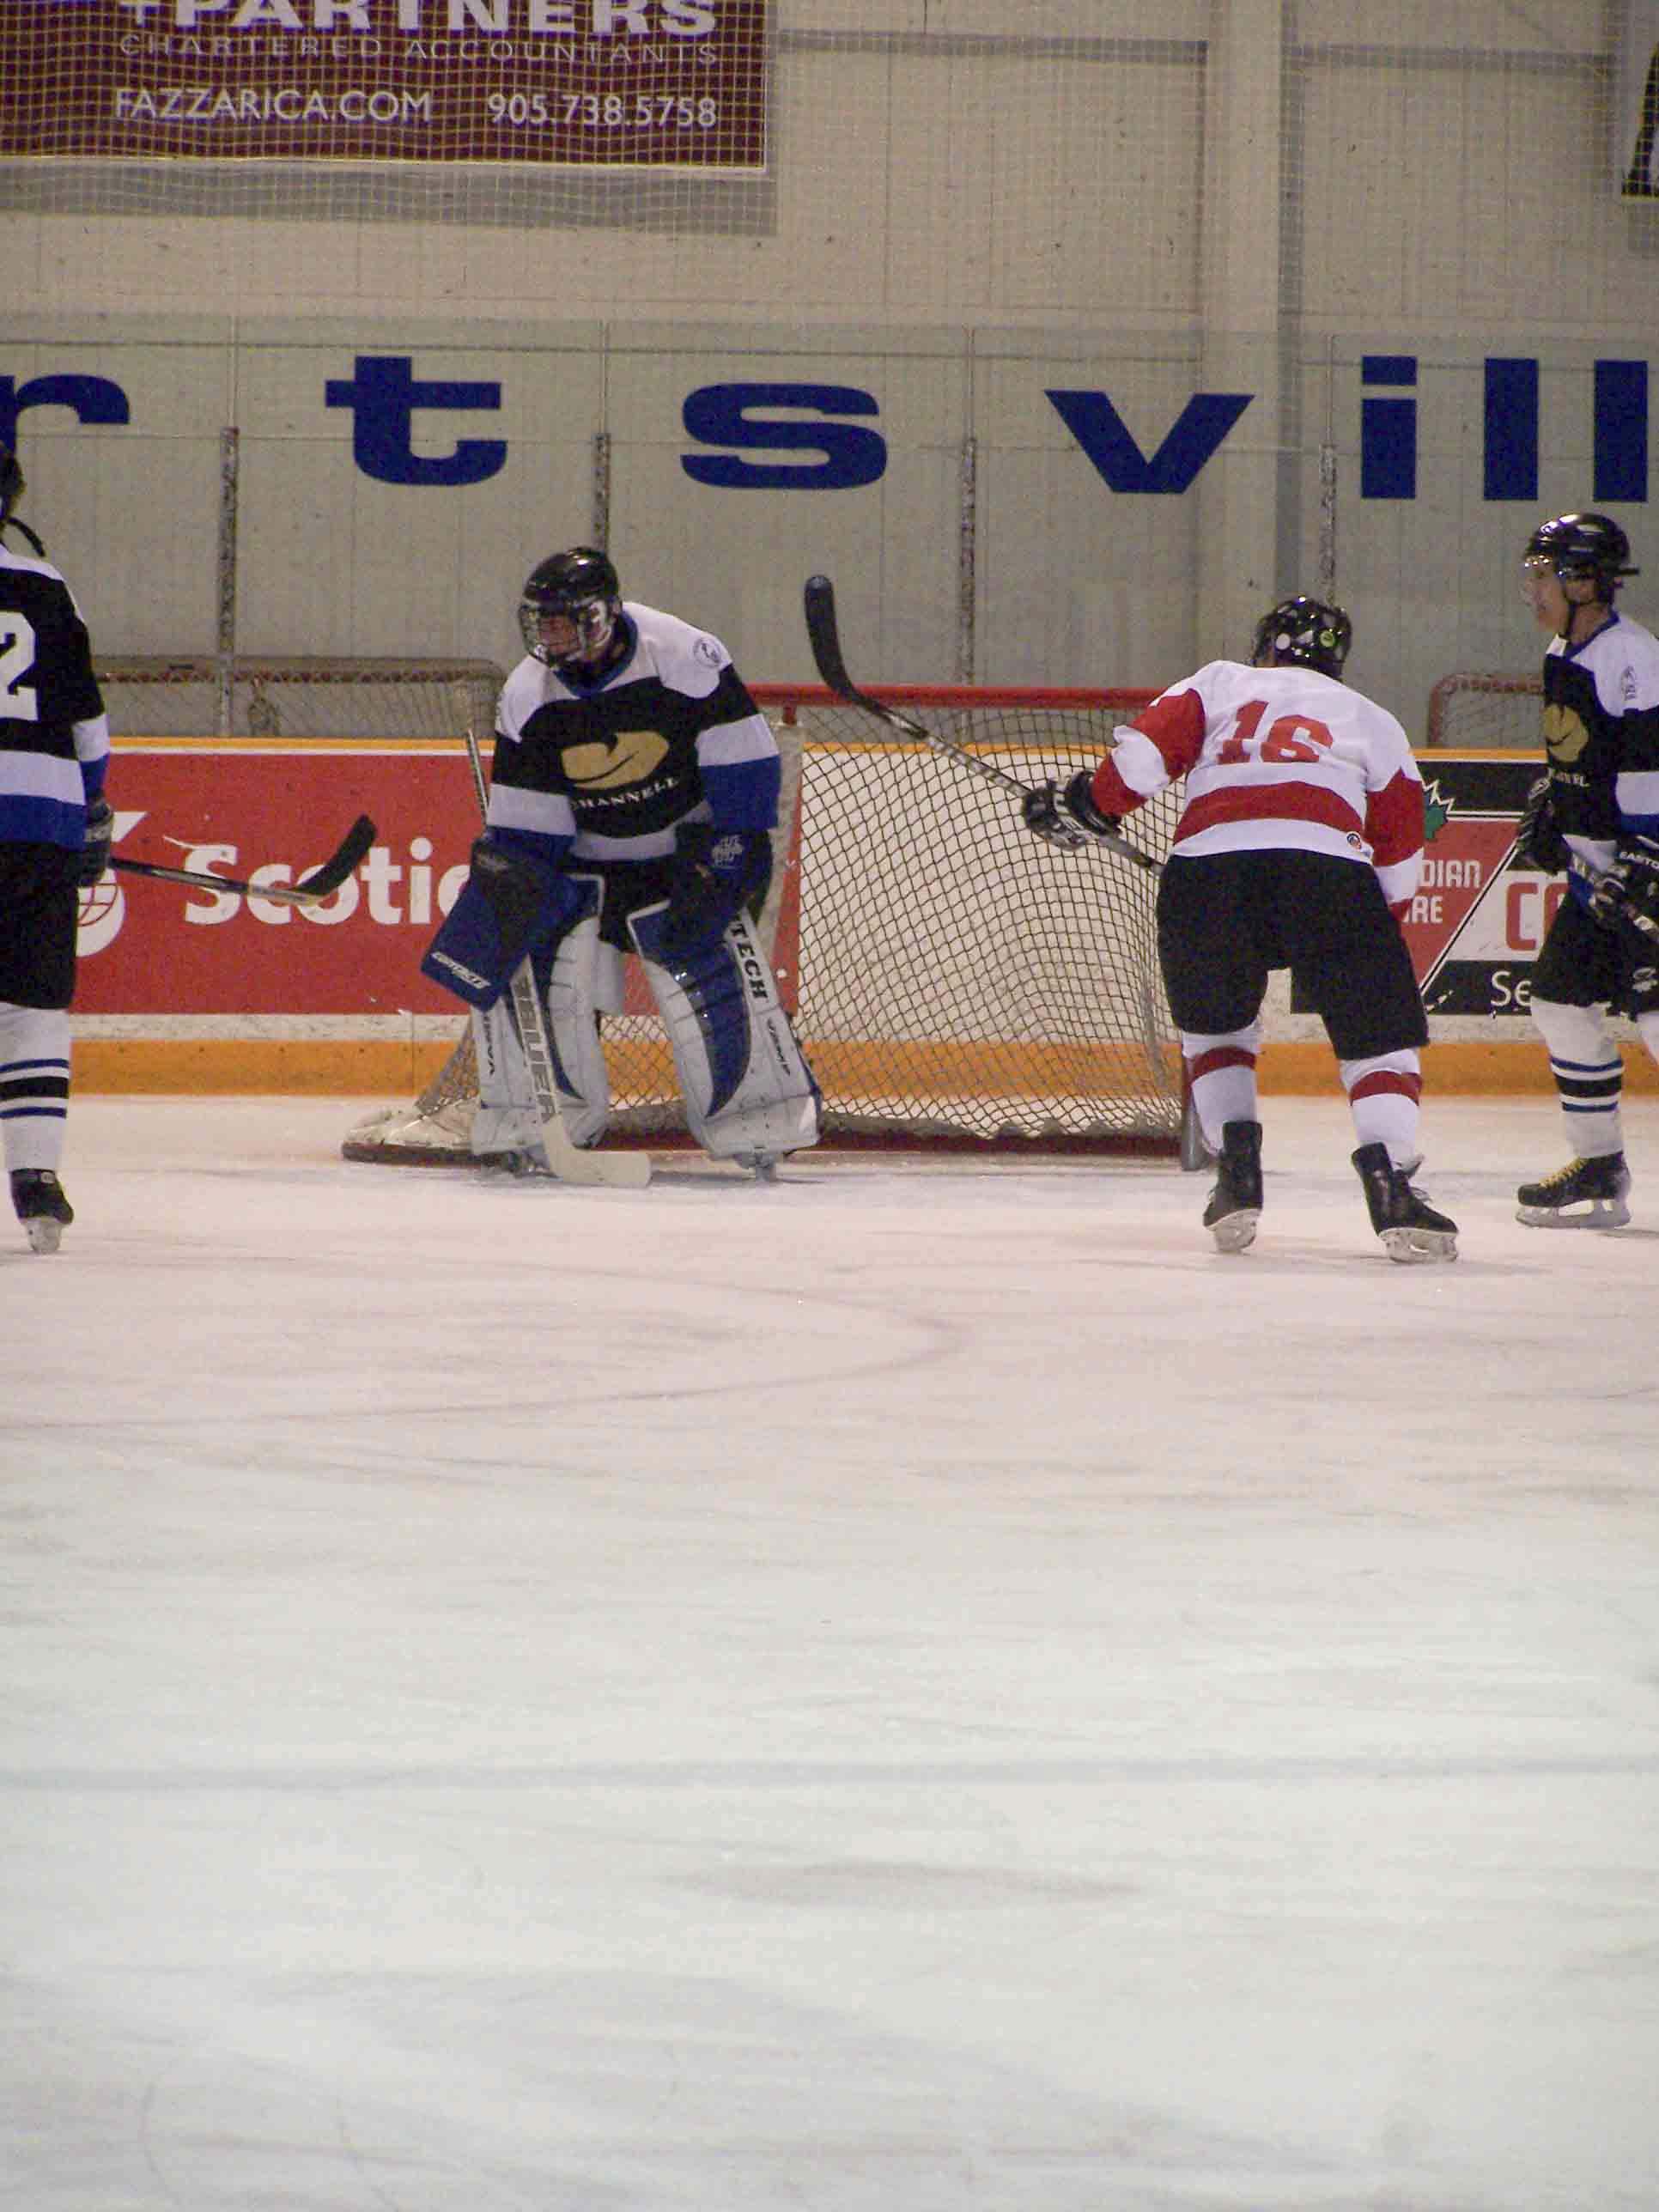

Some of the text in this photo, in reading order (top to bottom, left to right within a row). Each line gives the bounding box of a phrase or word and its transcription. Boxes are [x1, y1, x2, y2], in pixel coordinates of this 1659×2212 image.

[120, 35, 717, 64] CHARTERED ACCOUNTANTS
[115, 88, 717, 127] FAZZARICA.COM 905.738.5758
[1216, 699, 1334, 765] 16
